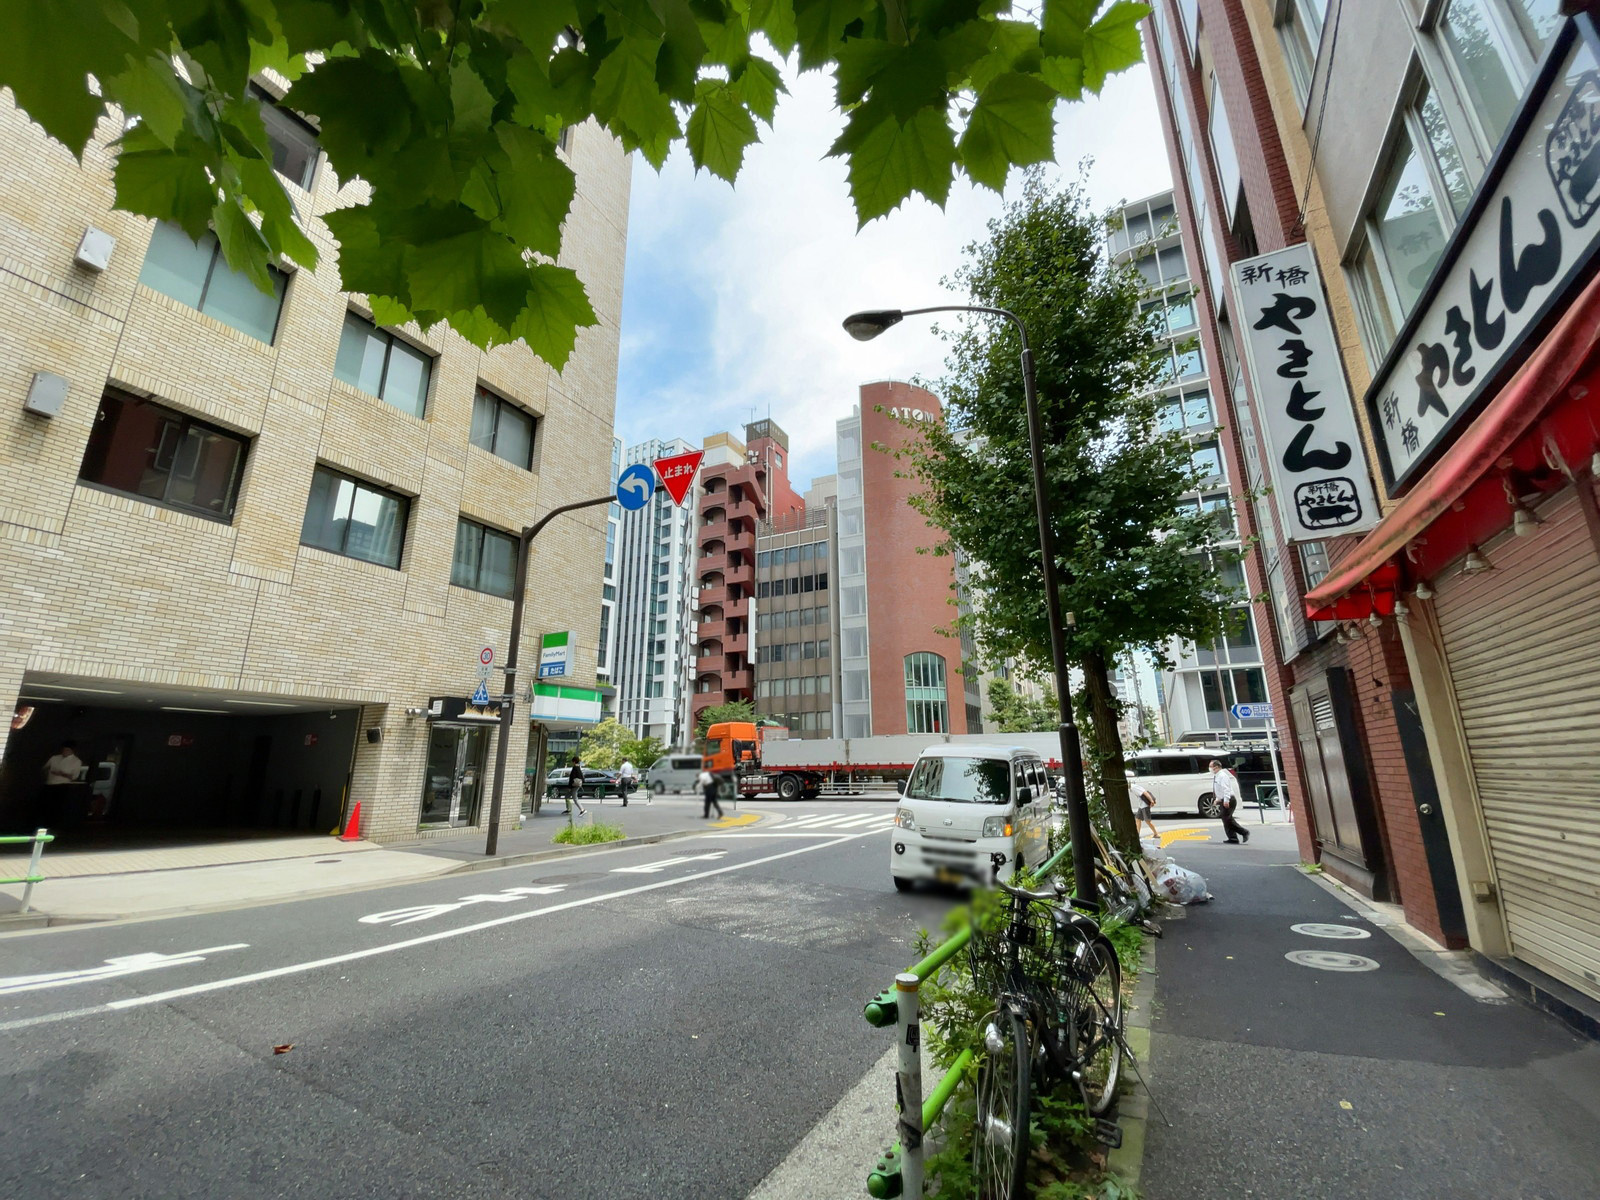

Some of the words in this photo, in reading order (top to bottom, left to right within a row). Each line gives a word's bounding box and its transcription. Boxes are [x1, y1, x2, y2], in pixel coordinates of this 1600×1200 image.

[1241, 263, 1309, 289] 新橋
[1416, 196, 1562, 418] やきとん
[1253, 293, 1352, 473] やきとん
[1383, 391, 1420, 458] 新橋
[664, 463, 694, 479] 止まれ
[1300, 490, 1354, 508] やきとん
[1308, 482, 1339, 495] 新橋
